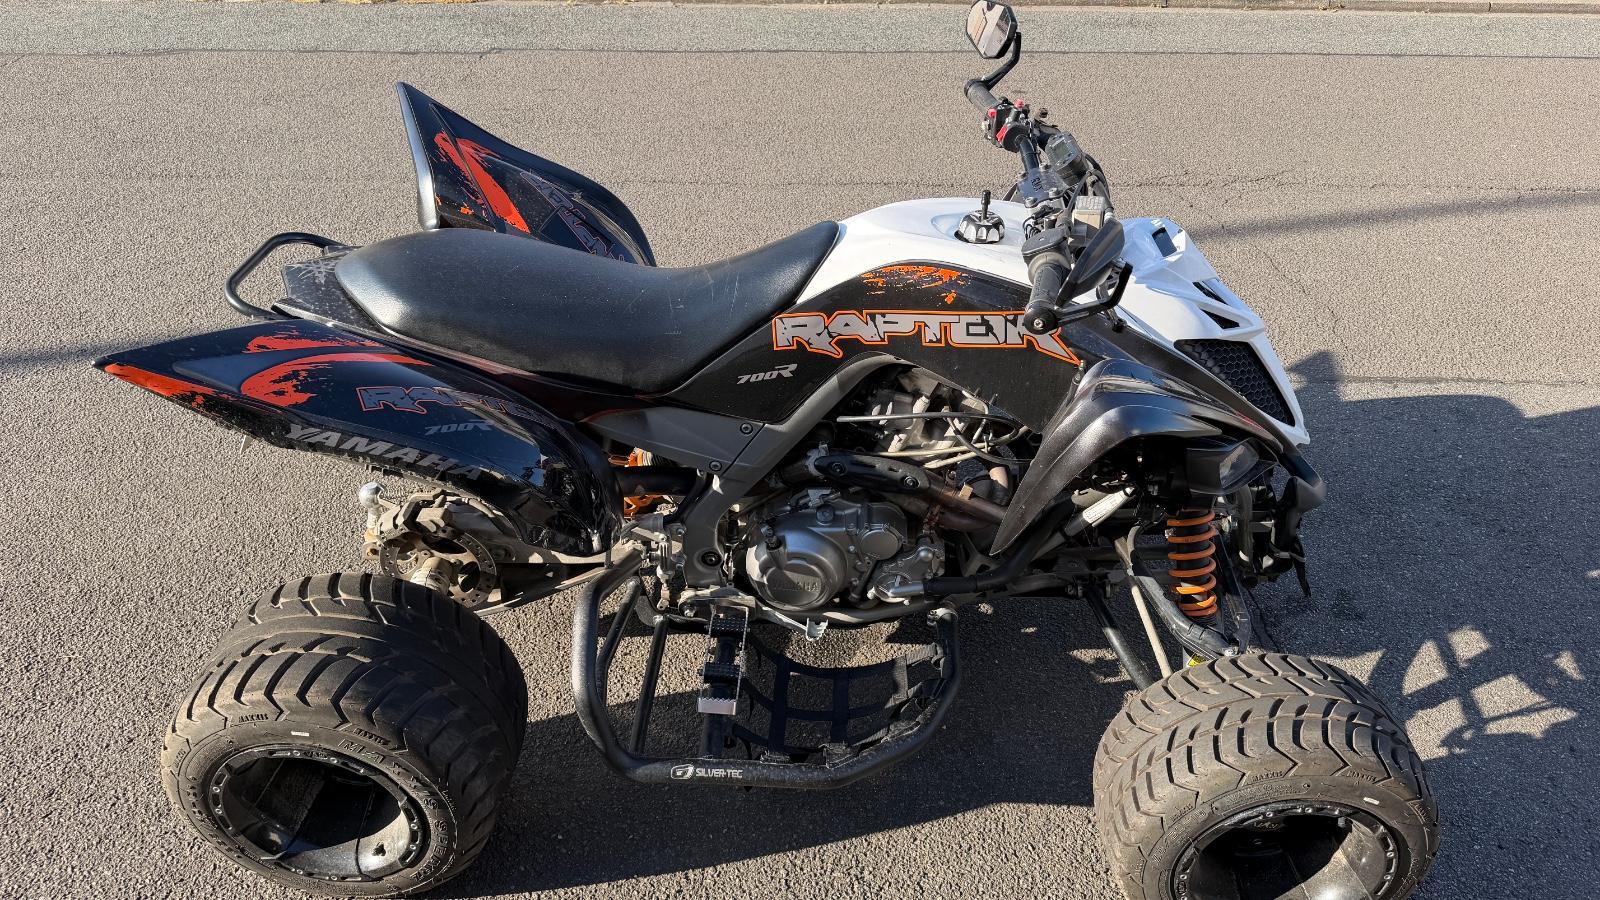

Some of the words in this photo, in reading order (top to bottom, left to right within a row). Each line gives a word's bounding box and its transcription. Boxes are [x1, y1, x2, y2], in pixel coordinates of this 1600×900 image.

[736, 363, 798, 385] 700R
[285, 423, 482, 481] YAMAHA
[695, 767, 743, 779] SILVER-TEC
